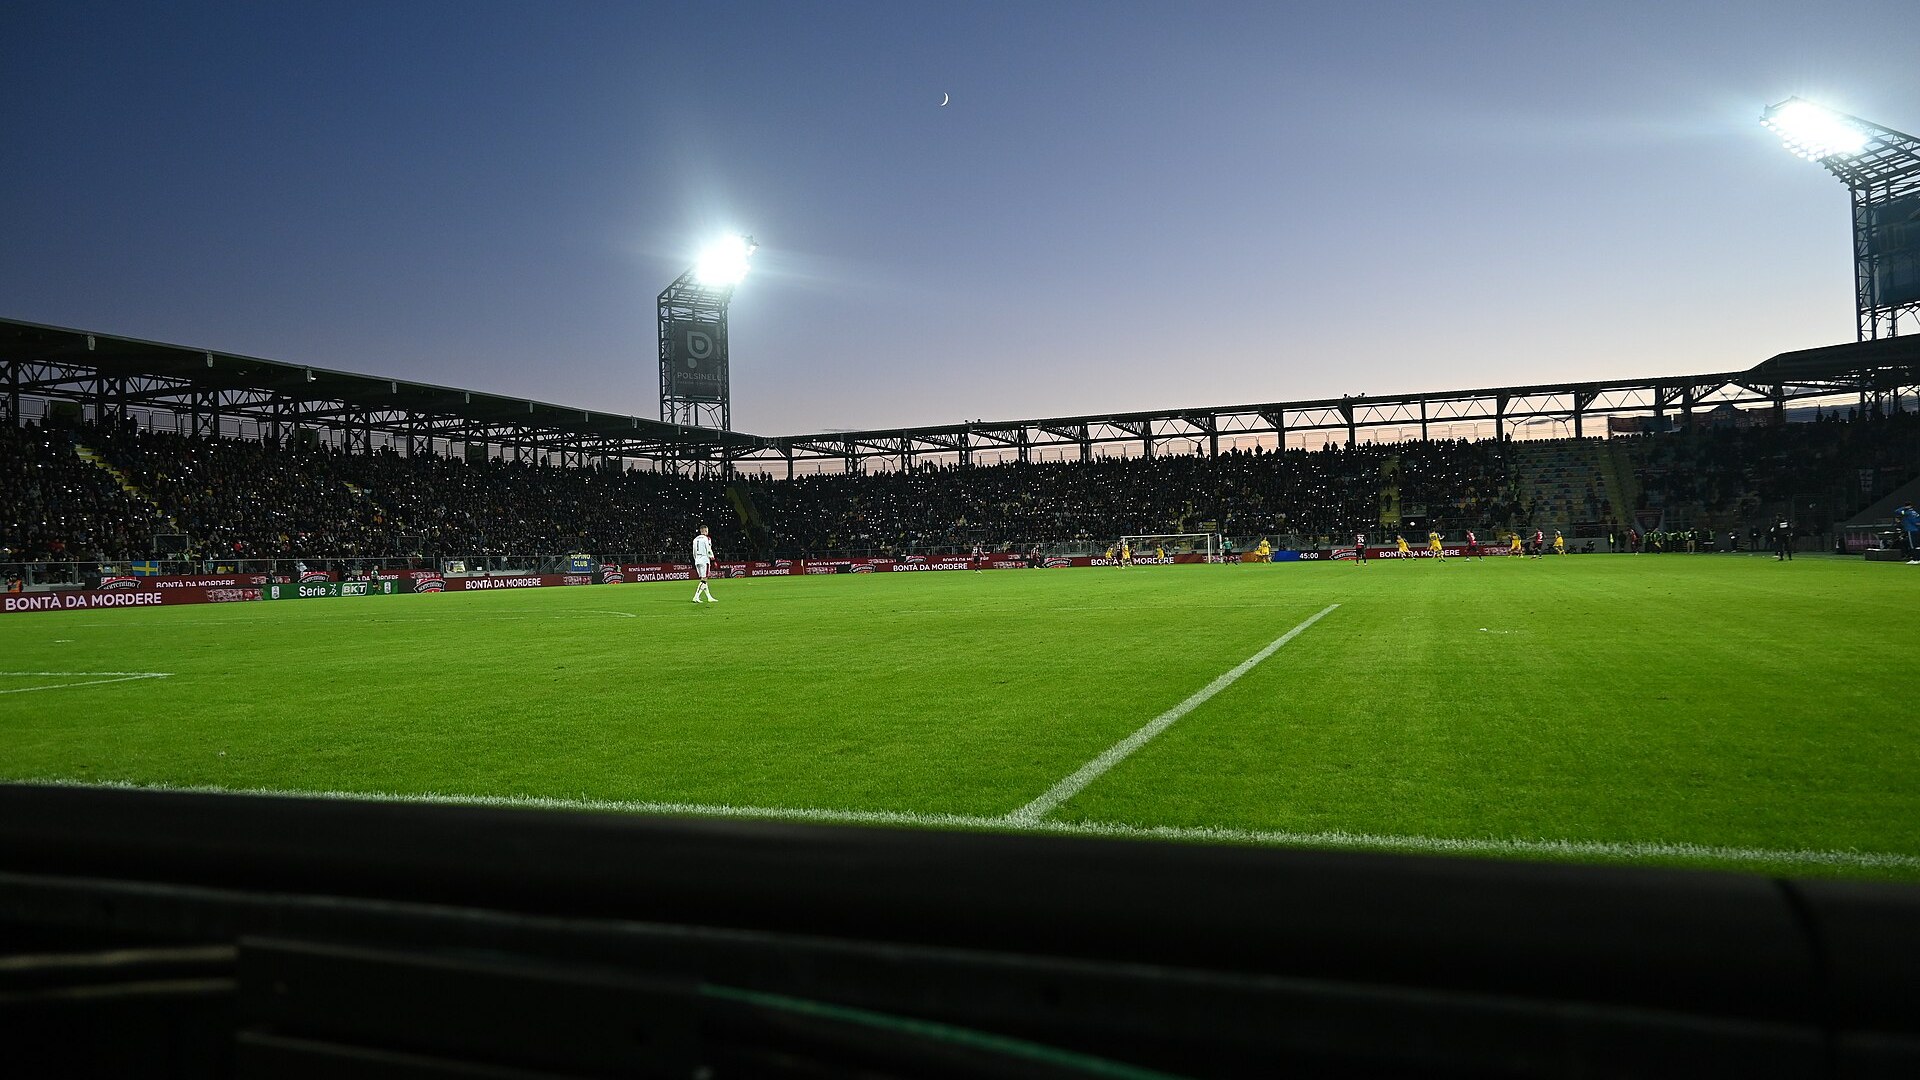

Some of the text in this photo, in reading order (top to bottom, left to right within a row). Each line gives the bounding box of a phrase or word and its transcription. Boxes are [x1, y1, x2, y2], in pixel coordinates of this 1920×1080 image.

[1421, 549, 1460, 557] MOERE
[893, 562, 968, 572] BONTÀ DA MORDERE
[637, 571, 656, 582] BONTÀ
[665, 571, 690, 580] MORDERE
[465, 577, 541, 590] BONTÀ DA MORDERE
[299, 585, 326, 597] Serie
[343, 585, 367, 594] BKT
[5, 592, 162, 611] BONTÀ DA MORDERE
